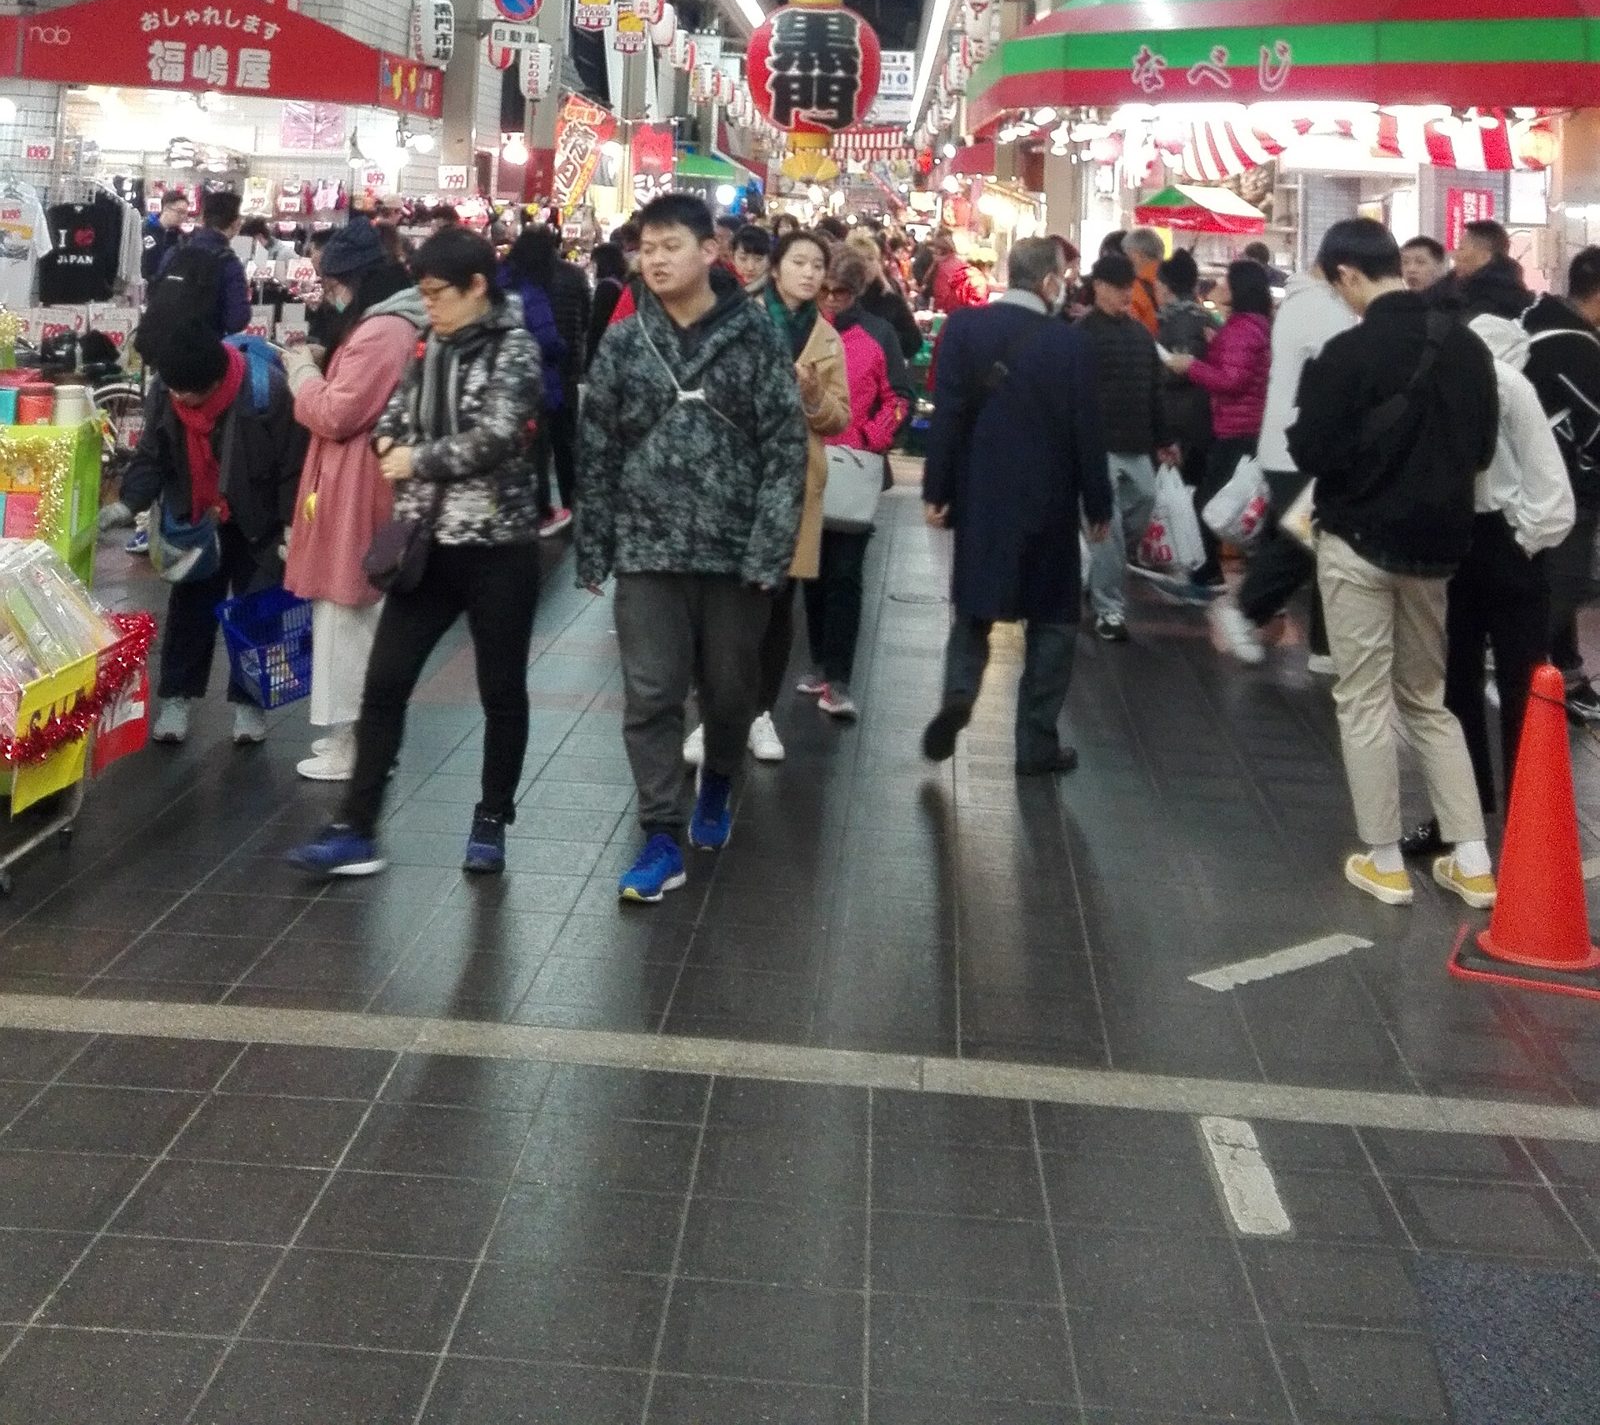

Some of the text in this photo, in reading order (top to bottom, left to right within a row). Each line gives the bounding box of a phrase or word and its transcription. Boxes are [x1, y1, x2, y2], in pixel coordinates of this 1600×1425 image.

[140, 6, 281, 40] おしゃれします
[433, 3, 452, 60] 黒門市場
[494, 28, 537, 44] 自動車
[147, 39, 272, 89] 福嶋屋
[770, 10, 861, 130] 黒門
[1131, 40, 1292, 94] なべじ
[57, 254, 94, 264] JAPAN
[58, 229, 67, 248] I
